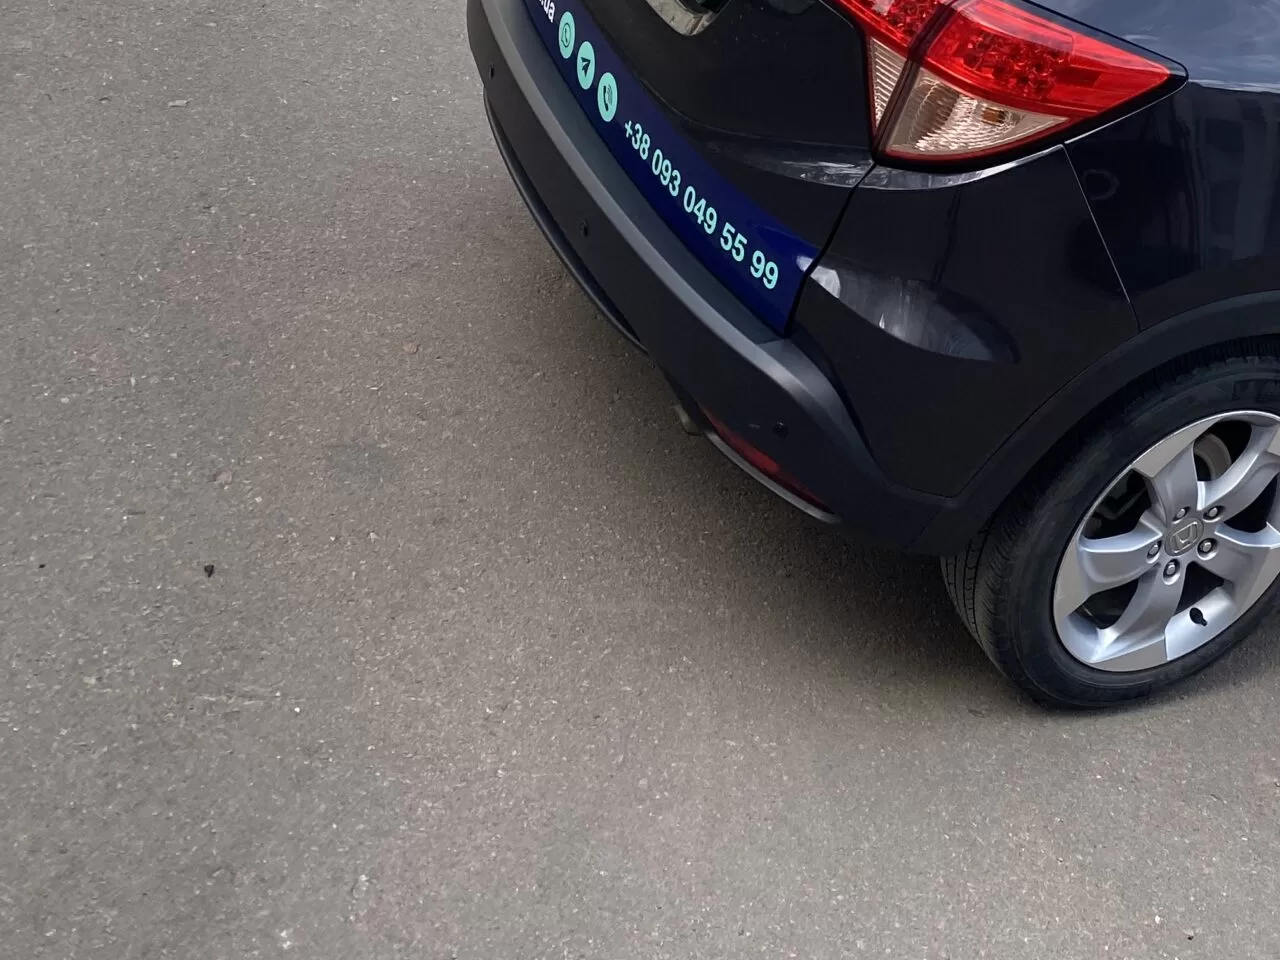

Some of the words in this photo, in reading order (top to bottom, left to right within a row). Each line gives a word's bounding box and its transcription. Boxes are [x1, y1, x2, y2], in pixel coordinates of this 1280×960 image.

[624, 120, 650, 160] +38
[652, 149, 681, 197] 093
[683, 186, 717, 234] 049
[720, 222, 748, 262] 55
[750, 250, 779, 290] 99
